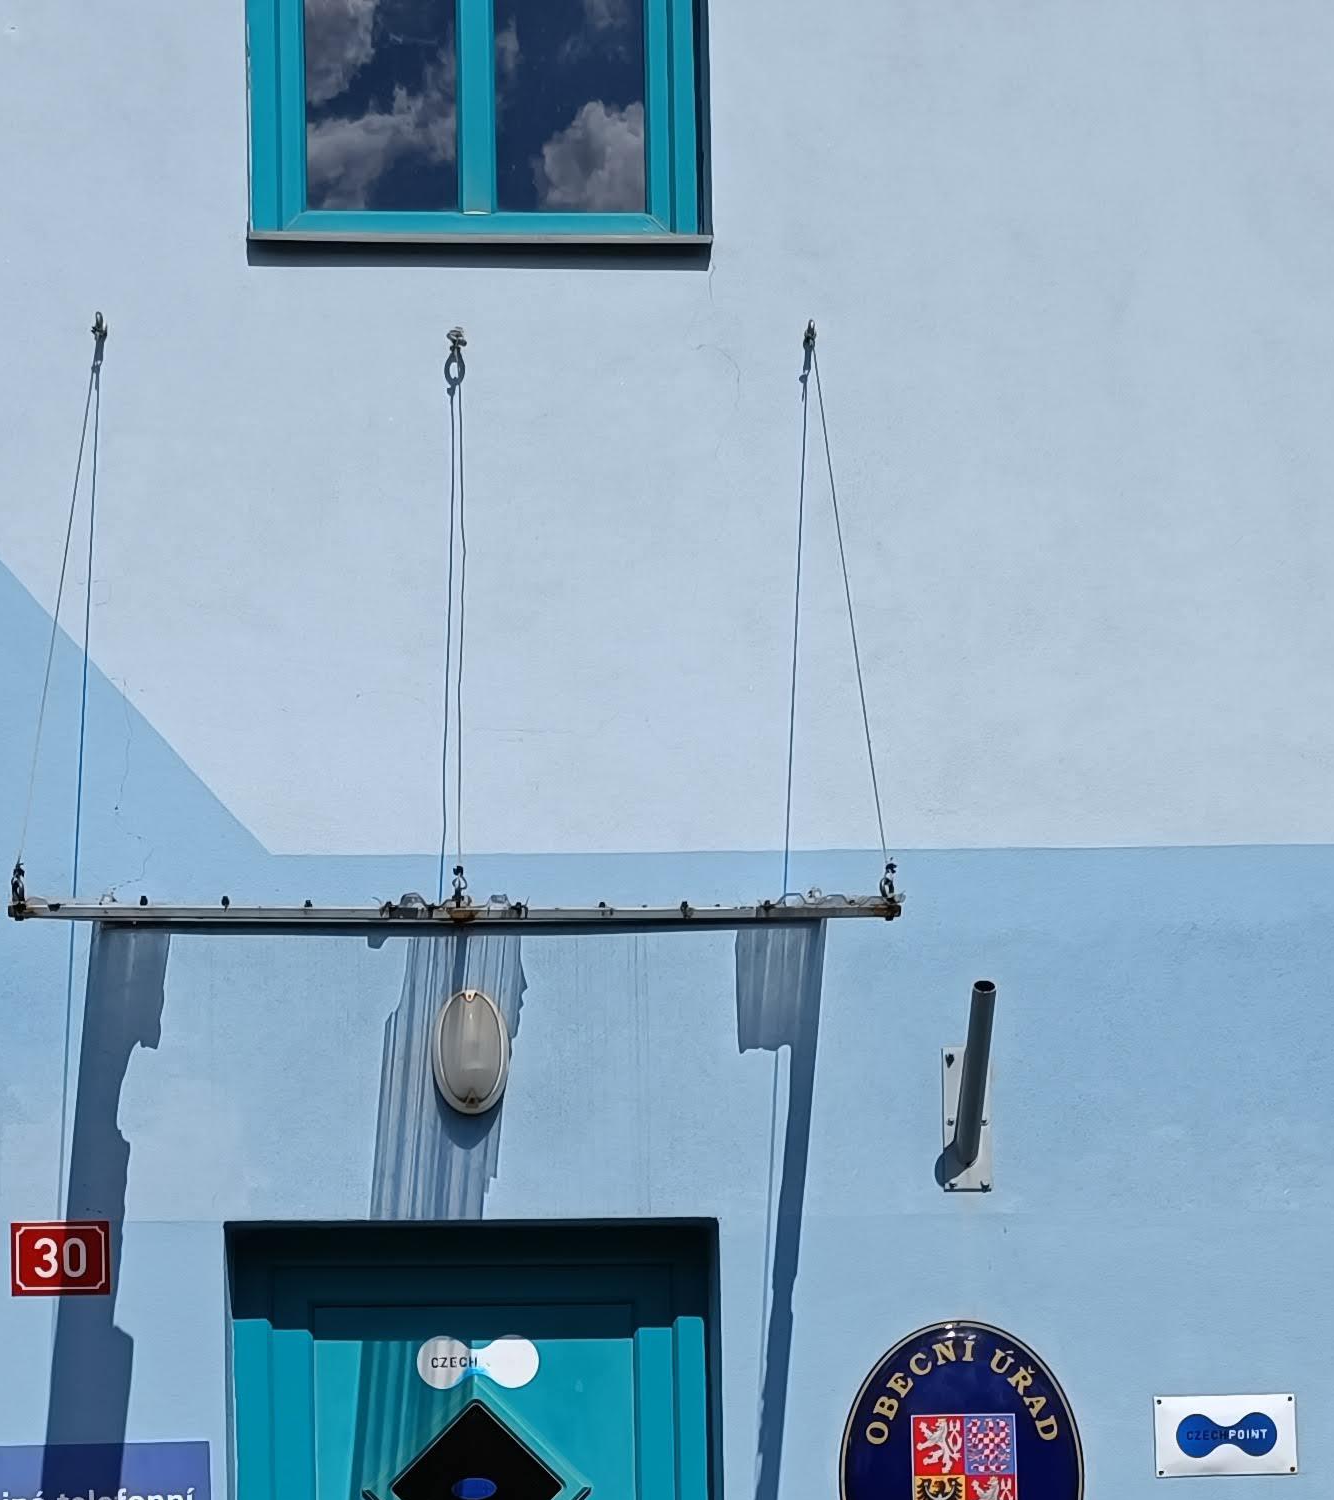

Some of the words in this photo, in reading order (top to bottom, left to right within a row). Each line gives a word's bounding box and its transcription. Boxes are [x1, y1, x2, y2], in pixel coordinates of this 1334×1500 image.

[33, 1237, 87, 1279] 30
[431, 1356, 478, 1369] CZECH
[865, 1333, 977, 1446] OBECNÍ
[990, 1349, 1059, 1442] ÚŘAD
